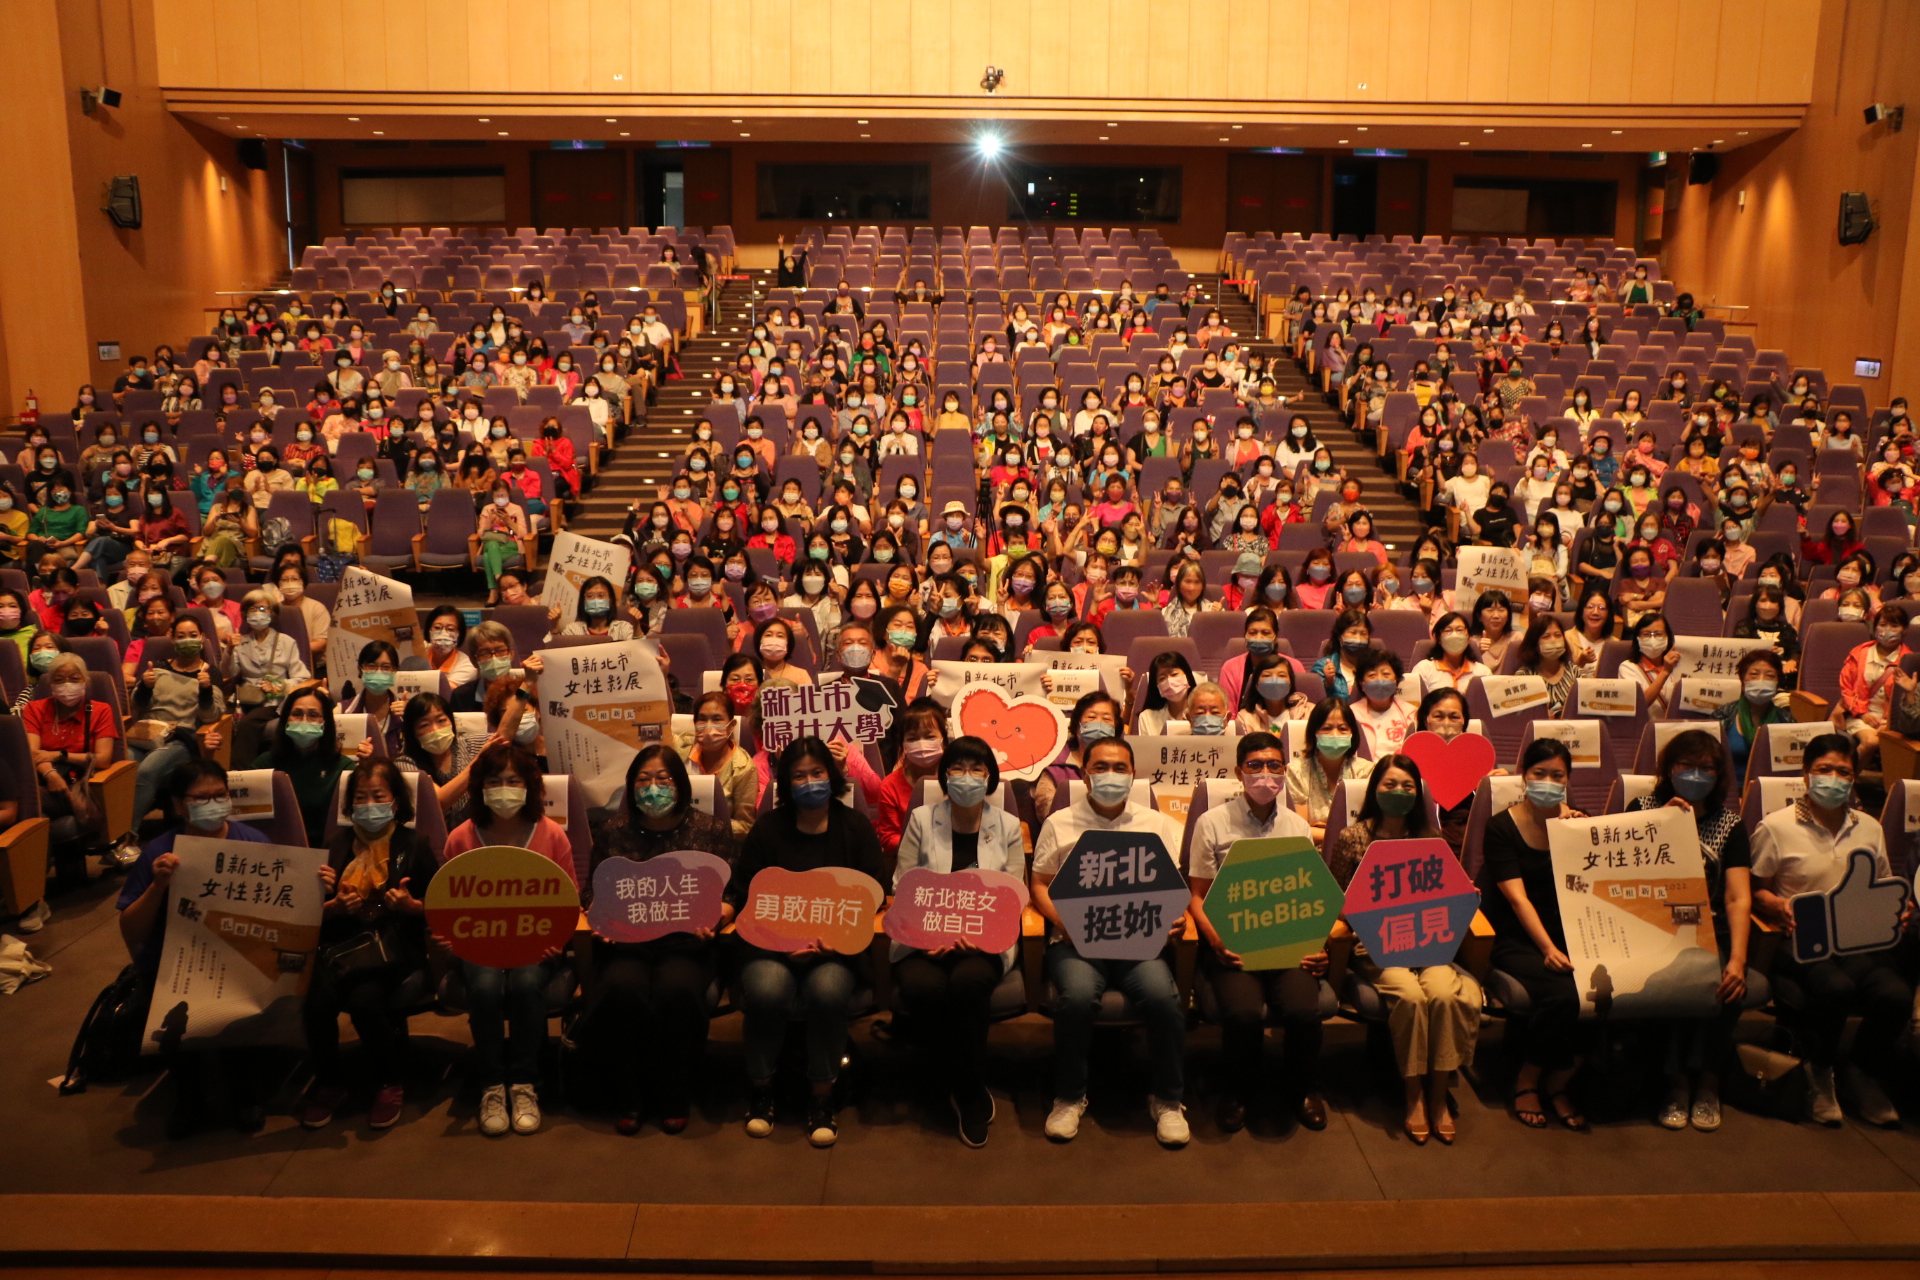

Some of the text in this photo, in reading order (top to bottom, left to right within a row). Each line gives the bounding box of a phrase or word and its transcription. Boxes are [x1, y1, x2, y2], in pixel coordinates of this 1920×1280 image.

[564, 554, 614, 575] 女性影展
[1473, 566, 1519, 581] 女性影展
[582, 653, 629, 673] 新北市
[564, 671, 643, 698] 女性影展
[763, 683, 851, 717] 新北市
[764, 713, 884, 750] 婦女大學
[1170, 747, 1219, 767] 新北市
[1602, 821, 1658, 844] 新北市
[227, 855, 285, 882] 新北市
[1078, 845, 1158, 889] 新北
[1582, 843, 1676, 871] 女性影展
[449, 875, 561, 898] Woman
[616, 874, 700, 900] 我的人生
[1227, 867, 1314, 904] #Break
[1369, 854, 1445, 903] 打破
[1664, 883, 1688, 891] 2022
[199, 878, 294, 908] 女性影展
[914, 886, 998, 913] 新北挺女
[627, 900, 691, 924] 我做主
[755, 893, 863, 927] 勇敢前行
[922, 911, 984, 936] 做自己
[1084, 900, 1163, 943] 挺妳
[1228, 898, 1326, 934] TheBias
[452, 914, 553, 939] Can Be
[1377, 906, 1454, 955] 偏見
